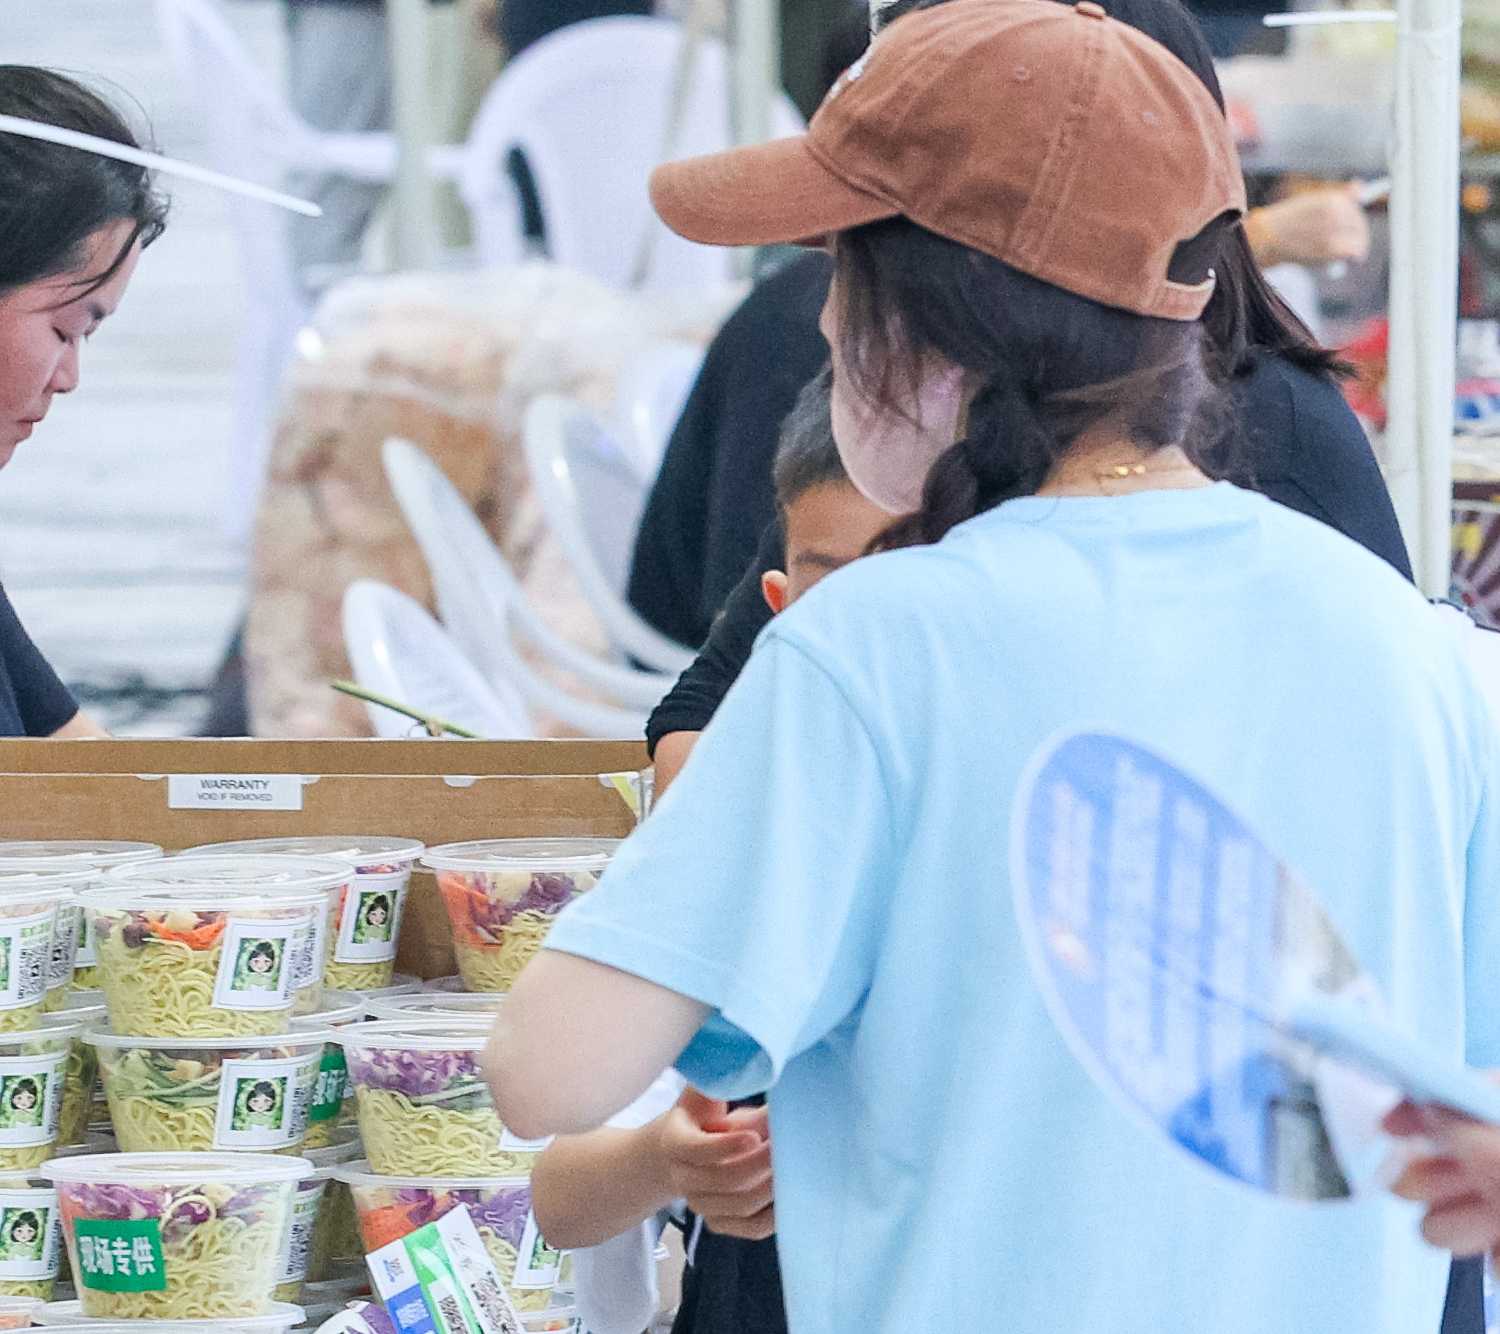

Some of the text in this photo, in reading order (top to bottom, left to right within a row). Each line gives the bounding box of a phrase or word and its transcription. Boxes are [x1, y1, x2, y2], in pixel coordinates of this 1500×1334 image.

[200, 779, 270, 790] WARRANTY
[196, 792, 218, 801] VOID
[229, 792, 273, 802] REMOVED
[79, 1236, 156, 1277] 现场专供
